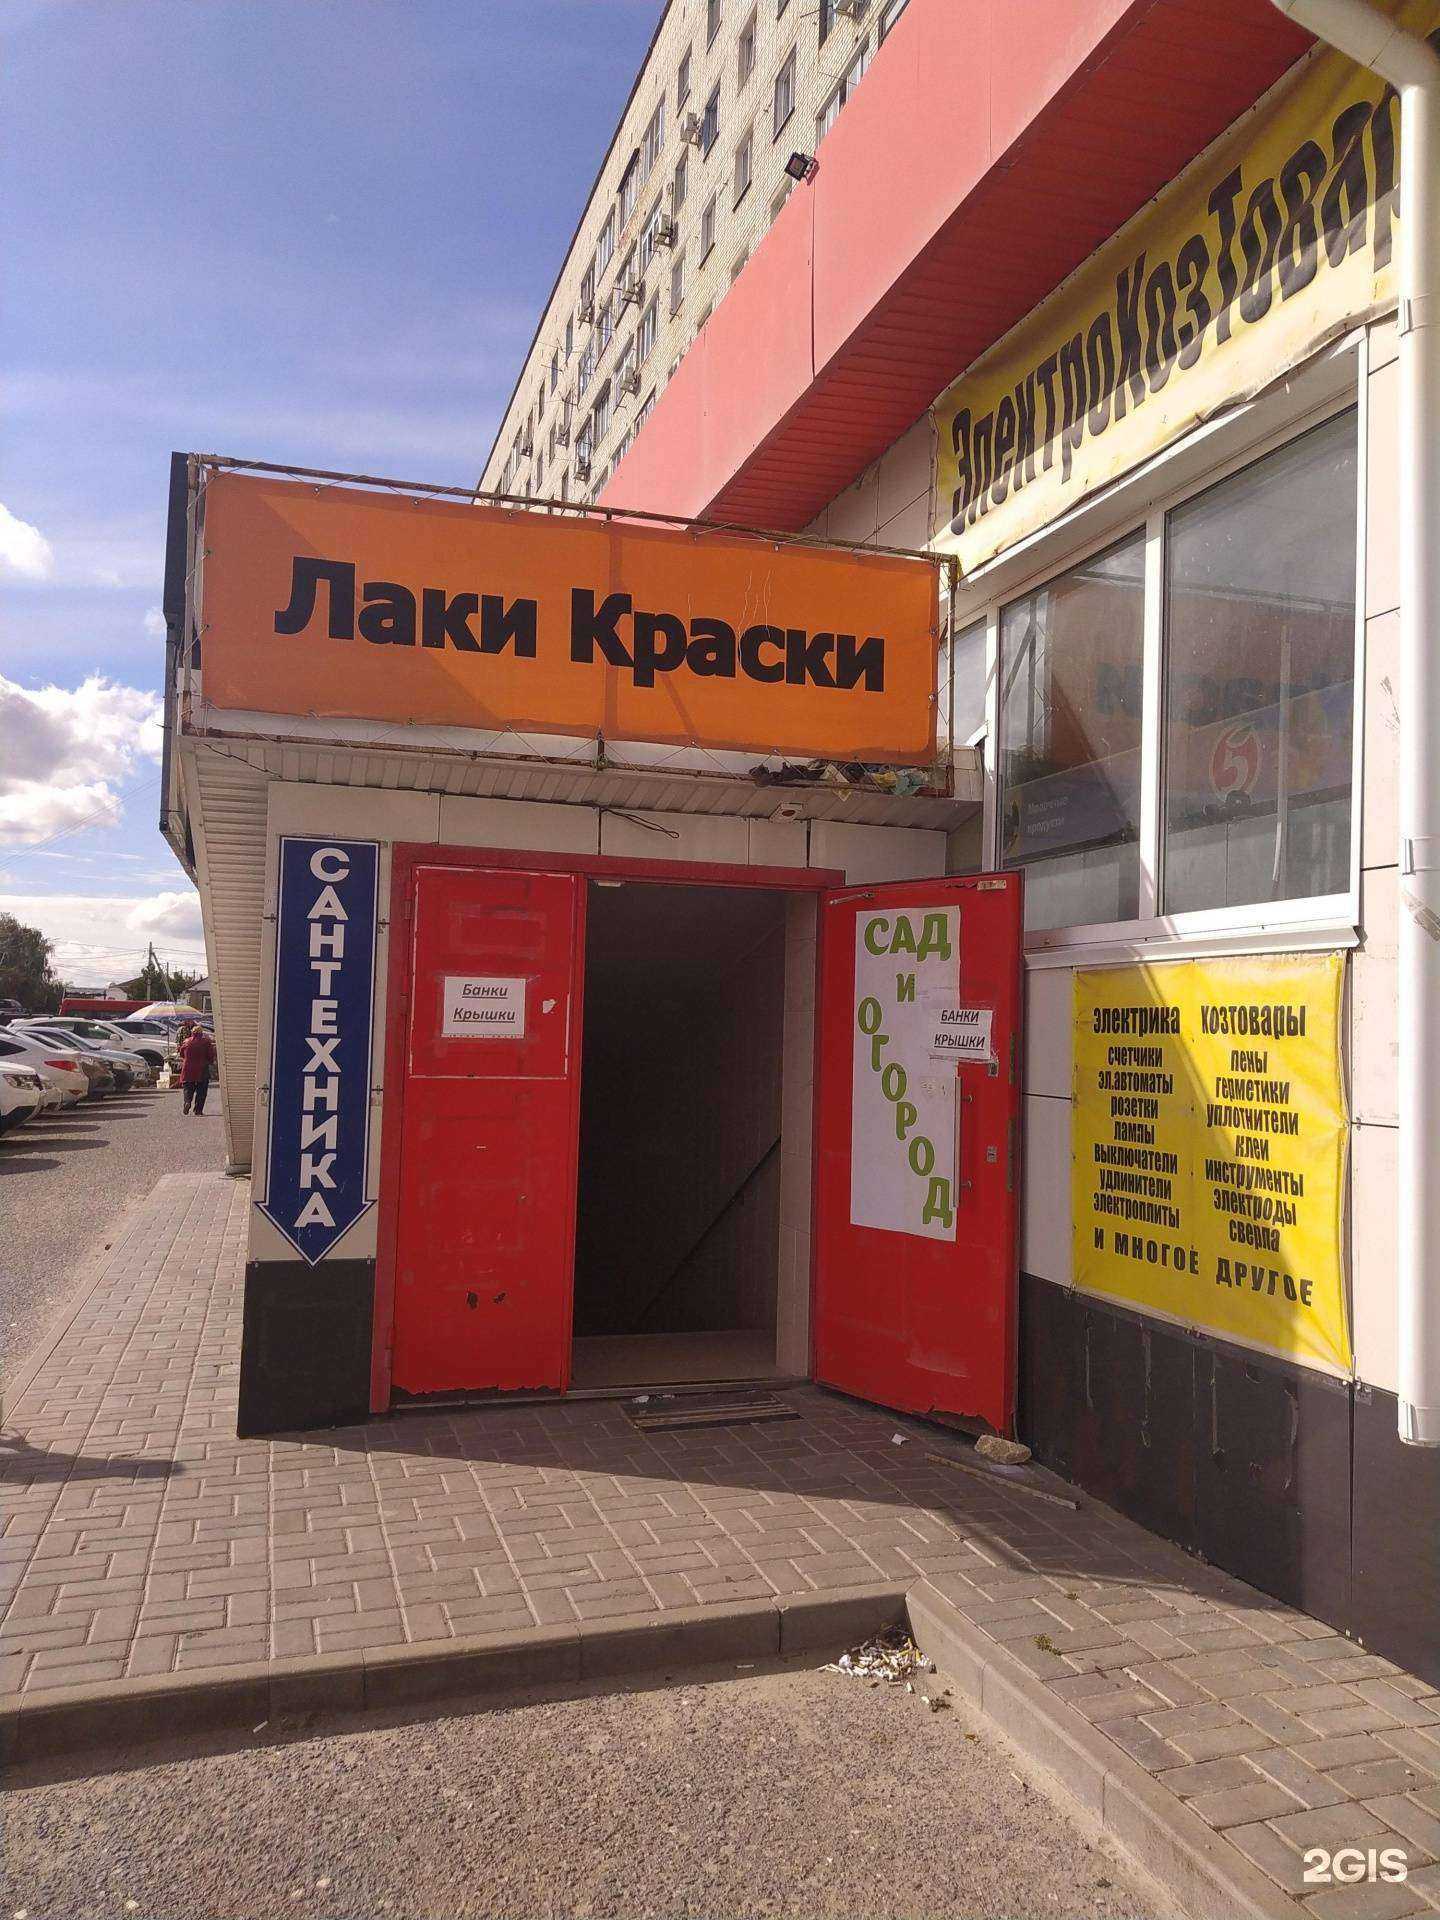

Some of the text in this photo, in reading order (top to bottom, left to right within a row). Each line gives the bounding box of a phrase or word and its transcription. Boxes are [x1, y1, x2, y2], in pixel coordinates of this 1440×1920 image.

[274, 556, 886, 692] Лаки Краски
[864, 912, 951, 962] САД
[462, 984, 508, 997] Банки
[896, 972, 916, 1002] И
[453, 1007, 515, 1021] Крышки
[941, 1009, 979, 1023] БАНКИ
[294, 847, 350, 1228] САНТЕХНИКА
[934, 1033, 985, 1048] КРЫШКИ
[1108, 1046, 1163, 1067] счетчики
[1230, 1050, 1268, 1073] пены
[1215, 1077, 1290, 1104] герметики
[857, 997, 953, 1228] ОГОРОД
[1111, 1096, 1159, 1119] розетки
[1206, 1103, 1299, 1135] уплотнители
[1114, 1121, 1155, 1144] лампы
[1235, 1135, 1269, 1161] клеи
[1094, 1143, 1178, 1174] выключатели
[1100, 1168, 1172, 1200] удлинители
[1205, 1159, 1304, 1197] инструменты
[1093, 1193, 1180, 1229] электроплиты
[1213, 1188, 1297, 1227] электроды
[1229, 1219, 1281, 1253] сверла
[1094, 1228, 1314, 1307] И МНОГОЕ ДРУГОЕ
